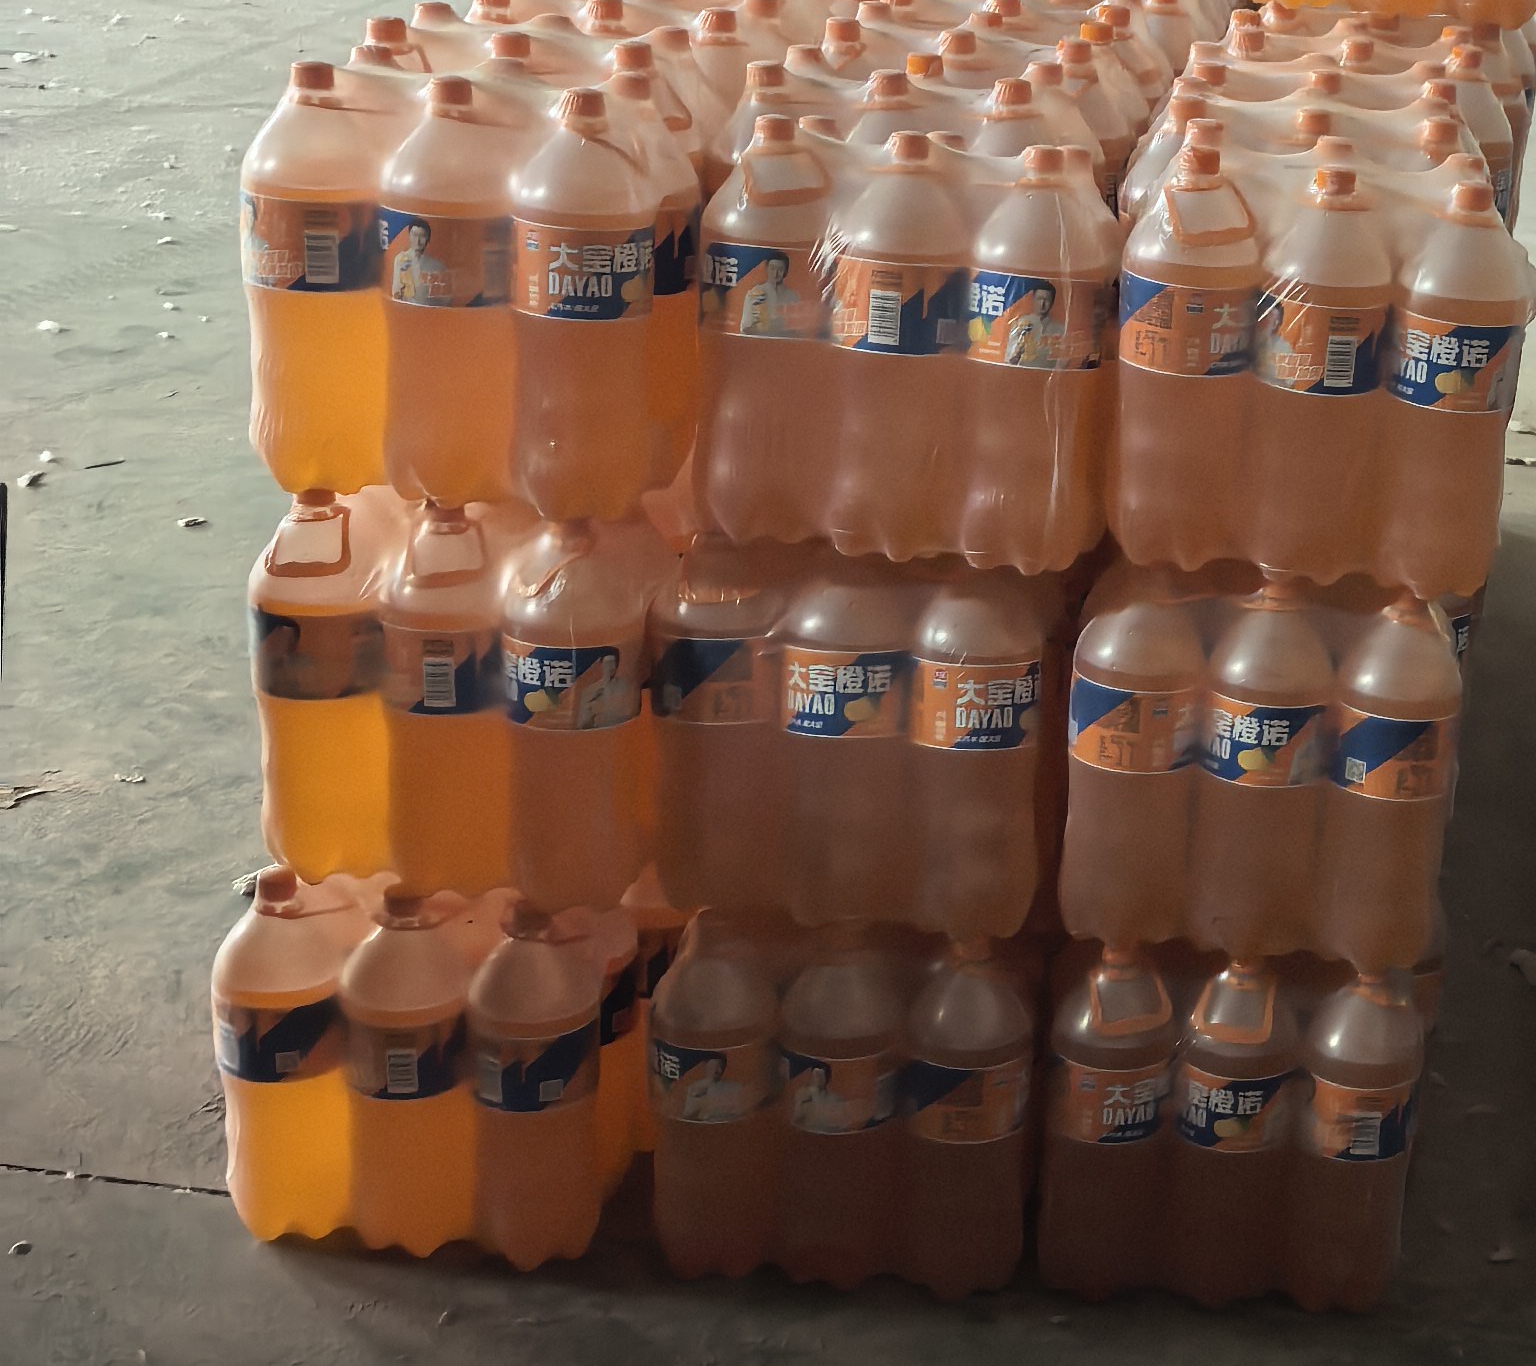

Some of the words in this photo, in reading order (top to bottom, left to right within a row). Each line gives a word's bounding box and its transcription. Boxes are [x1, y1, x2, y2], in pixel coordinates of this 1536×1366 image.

[548, 271, 613, 298] DAYAO
[788, 661, 893, 694] 大窑橙诺
[956, 679, 1041, 706] 大窑橙
[955, 706, 1013, 729] DAYAO
